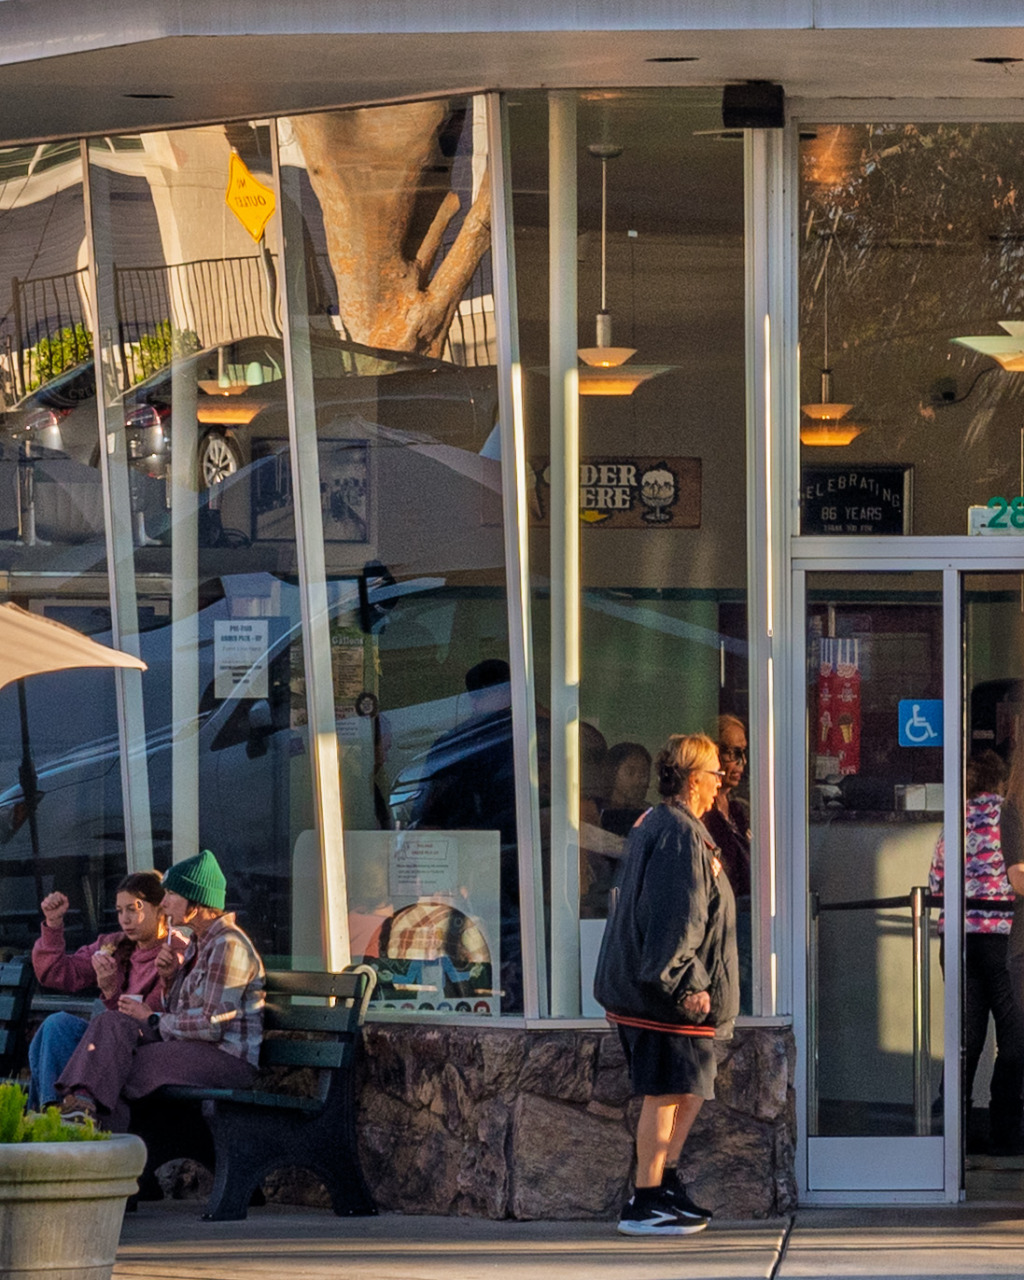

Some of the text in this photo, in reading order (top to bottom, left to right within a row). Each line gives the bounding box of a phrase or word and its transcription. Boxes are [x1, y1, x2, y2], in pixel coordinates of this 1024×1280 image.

[580, 464, 638, 487] DER
[580, 487, 631, 509] ERE
[821, 506, 883, 521] 86 YEARS
[331, 634, 364, 645] Gallons
